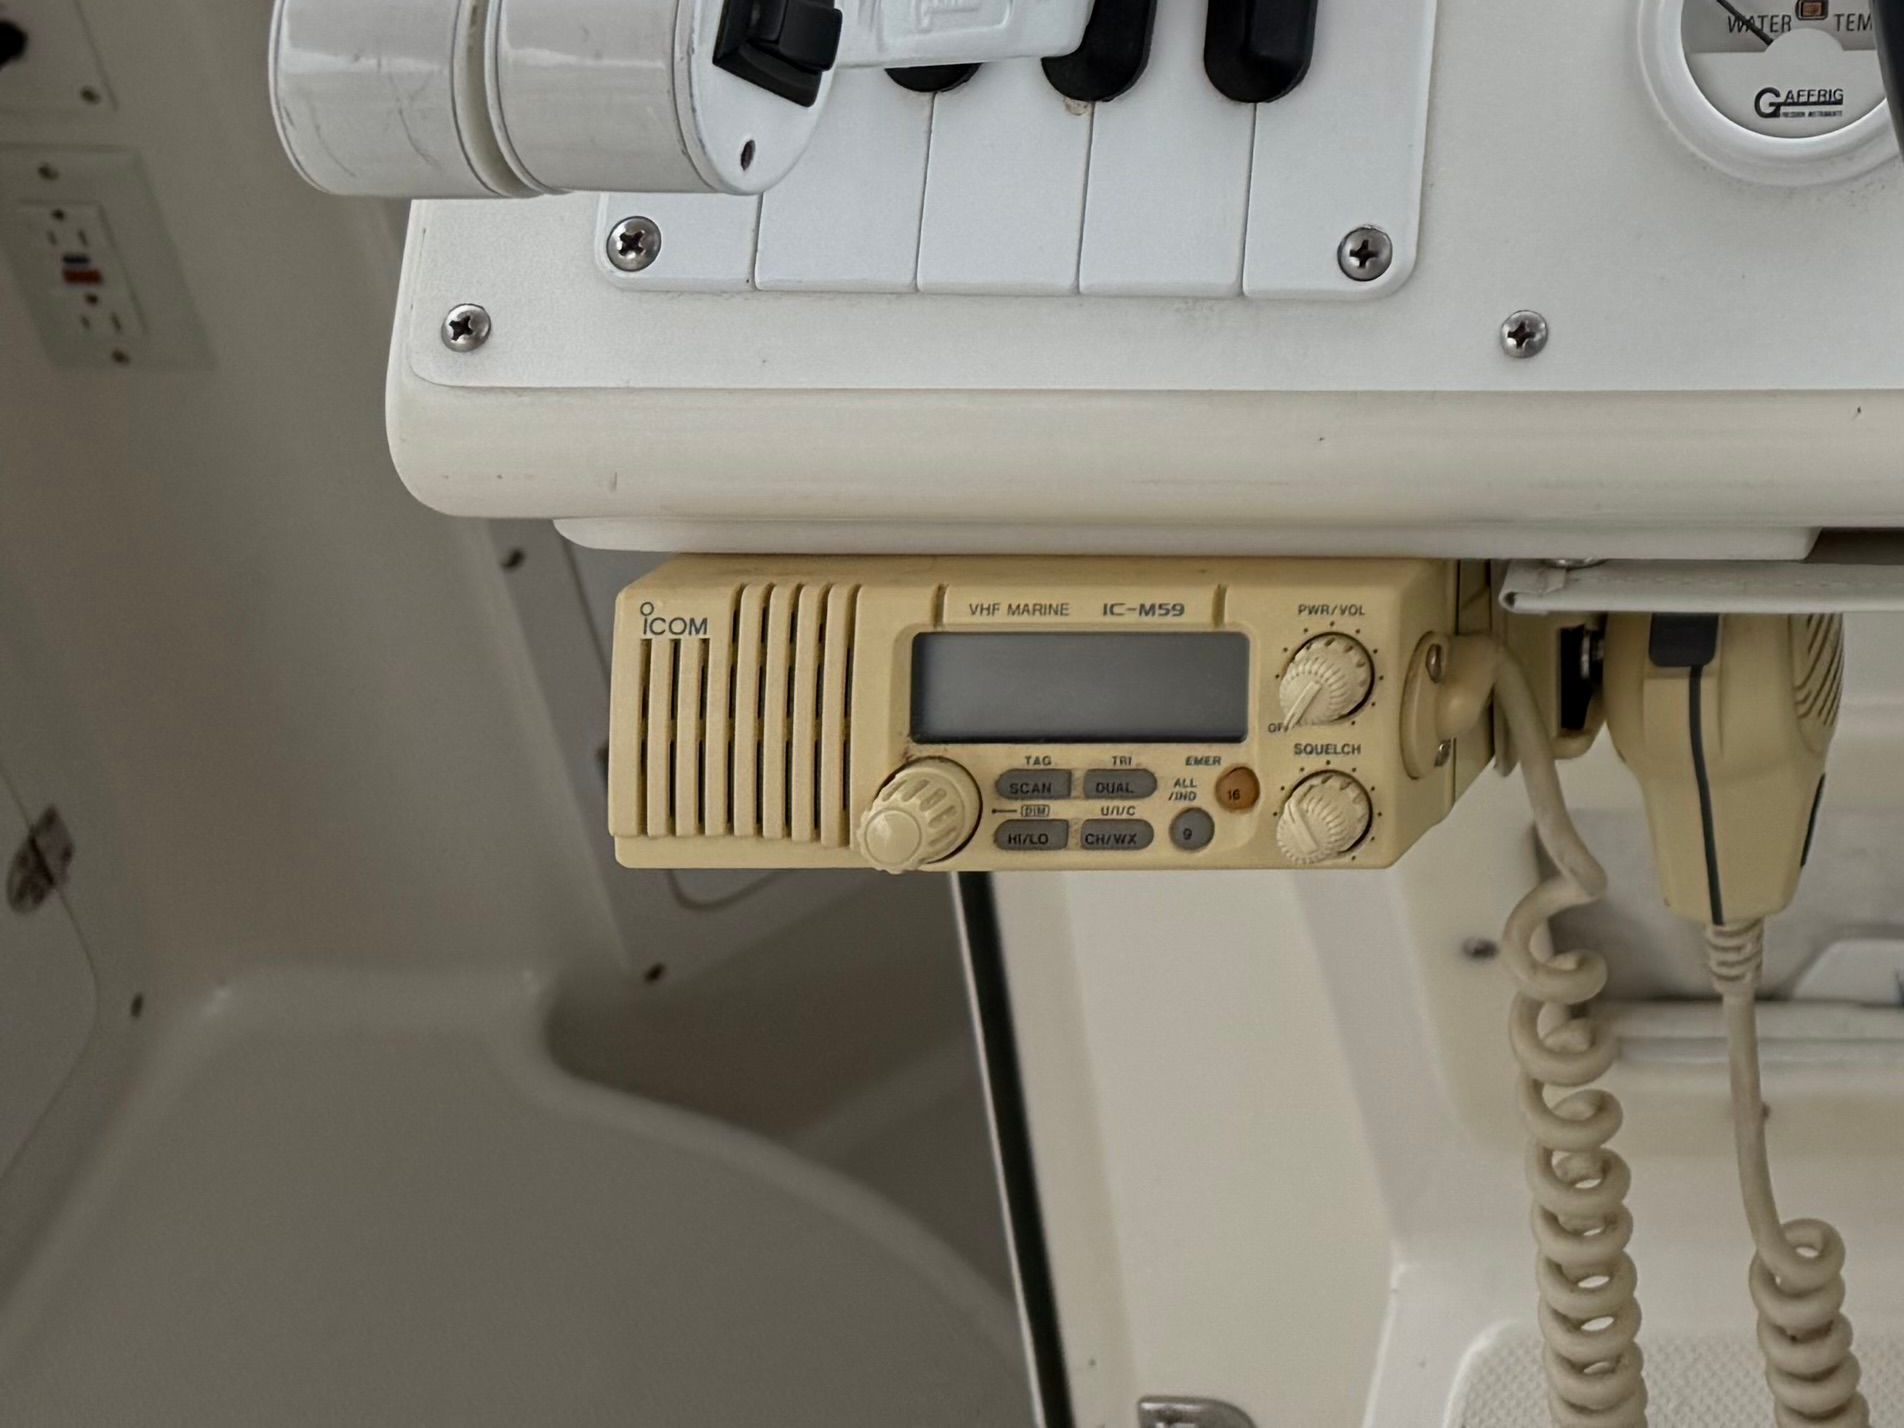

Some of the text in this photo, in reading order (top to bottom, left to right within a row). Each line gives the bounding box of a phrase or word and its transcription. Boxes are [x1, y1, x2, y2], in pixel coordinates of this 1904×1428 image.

[1727, 13, 1874, 33] WATER TEM
[969, 602, 1185, 618] VHF MARINE IC-M59
[1297, 603, 1366, 617] PWR/VOL
[1293, 742, 1362, 757] SQUELCH
[1025, 755, 1053, 767] TAG
[1185, 755, 1222, 767] EMER
[1008, 780, 1053, 796] SCAN
[1095, 781, 1134, 796] DUAL
[1007, 831, 1049, 846] HI/LO
[1084, 831, 1138, 847] CH/WX
